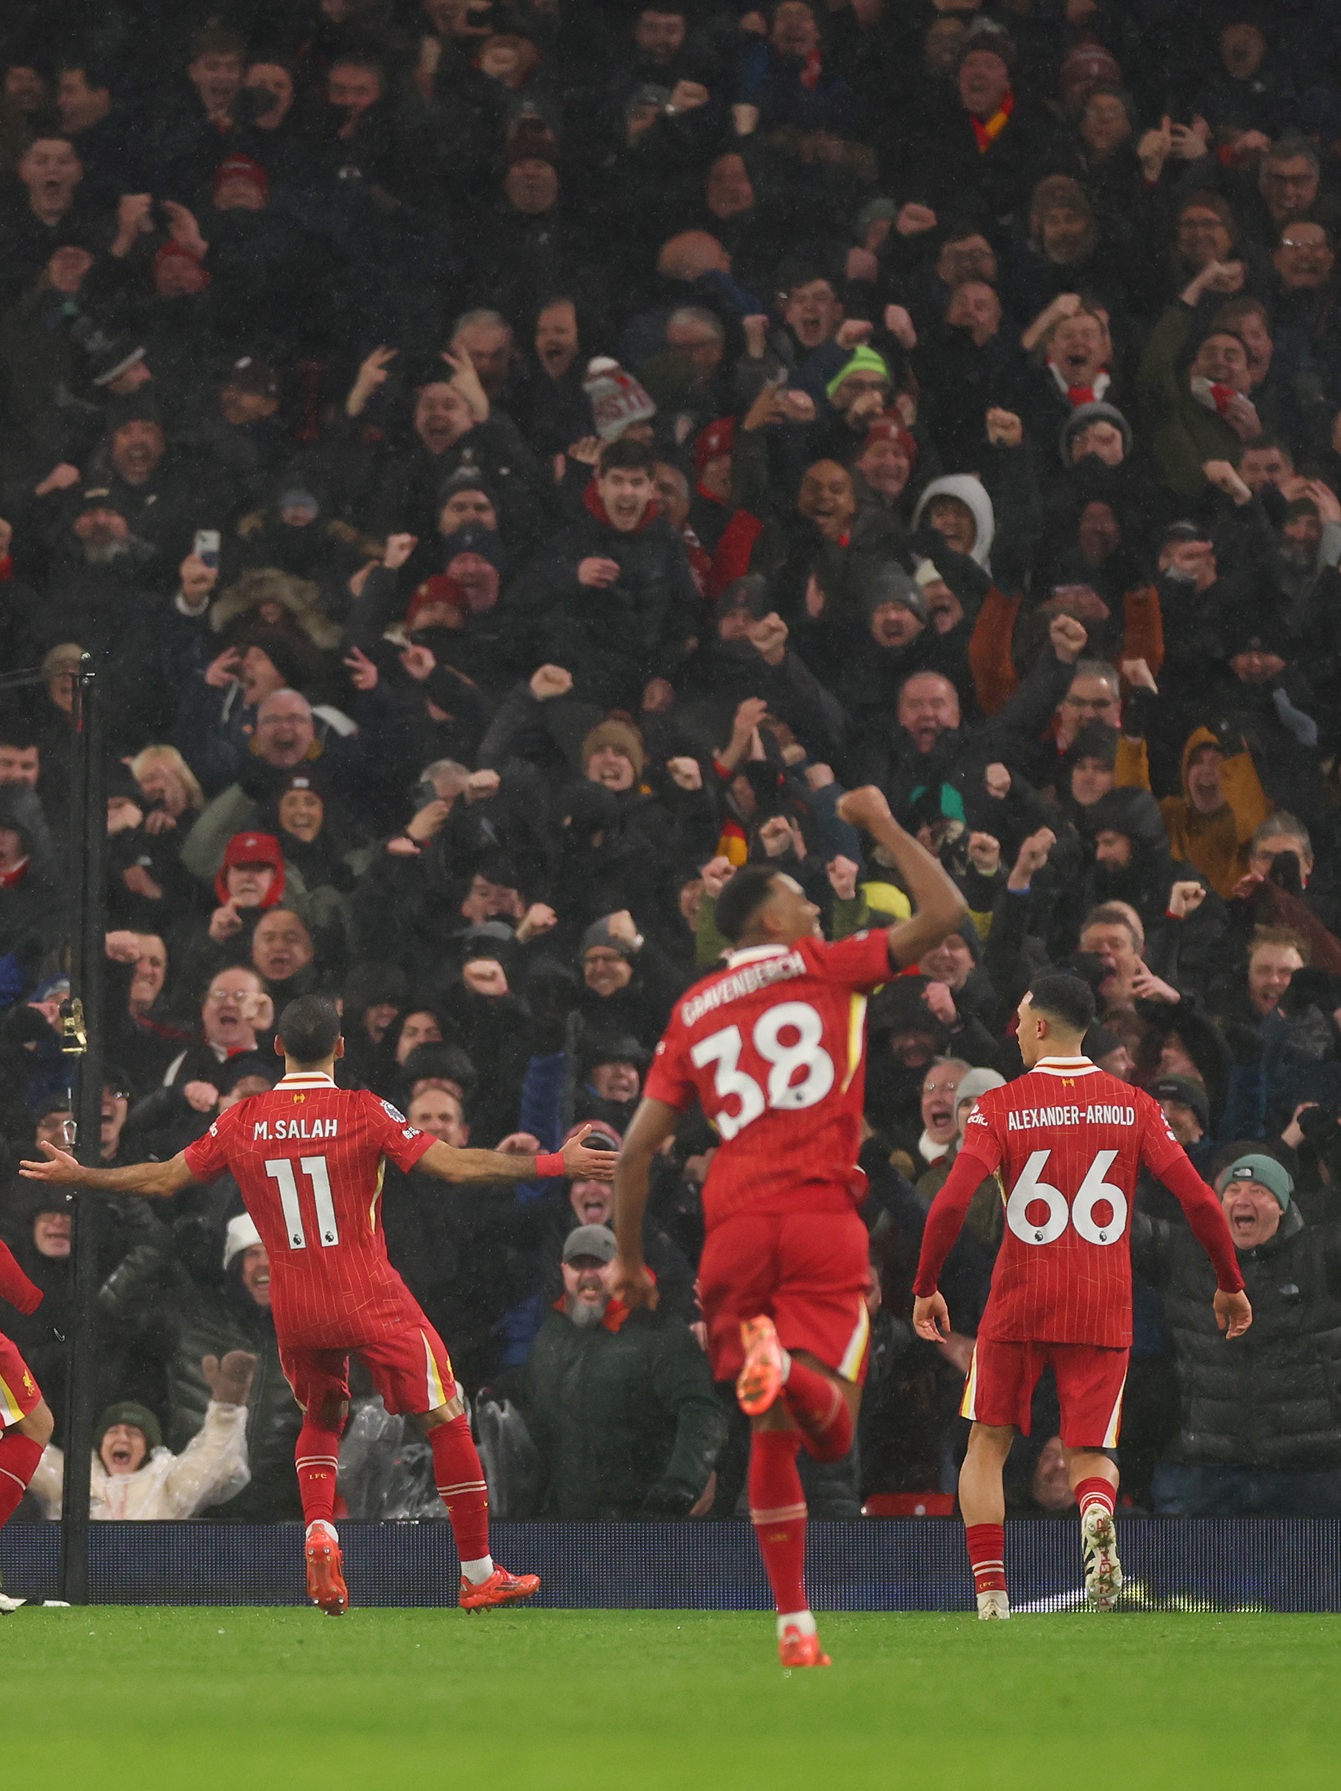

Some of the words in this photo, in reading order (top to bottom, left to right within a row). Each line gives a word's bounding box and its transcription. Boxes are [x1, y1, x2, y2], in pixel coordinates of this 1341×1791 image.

[690, 1001, 835, 1140] 38
[253, 1119, 338, 1141] M.SALAH
[1008, 1105, 1135, 1131] ALEXANDER-ARNOLD
[264, 1156, 340, 1250] 11
[1006, 1149, 1128, 1246] 66
